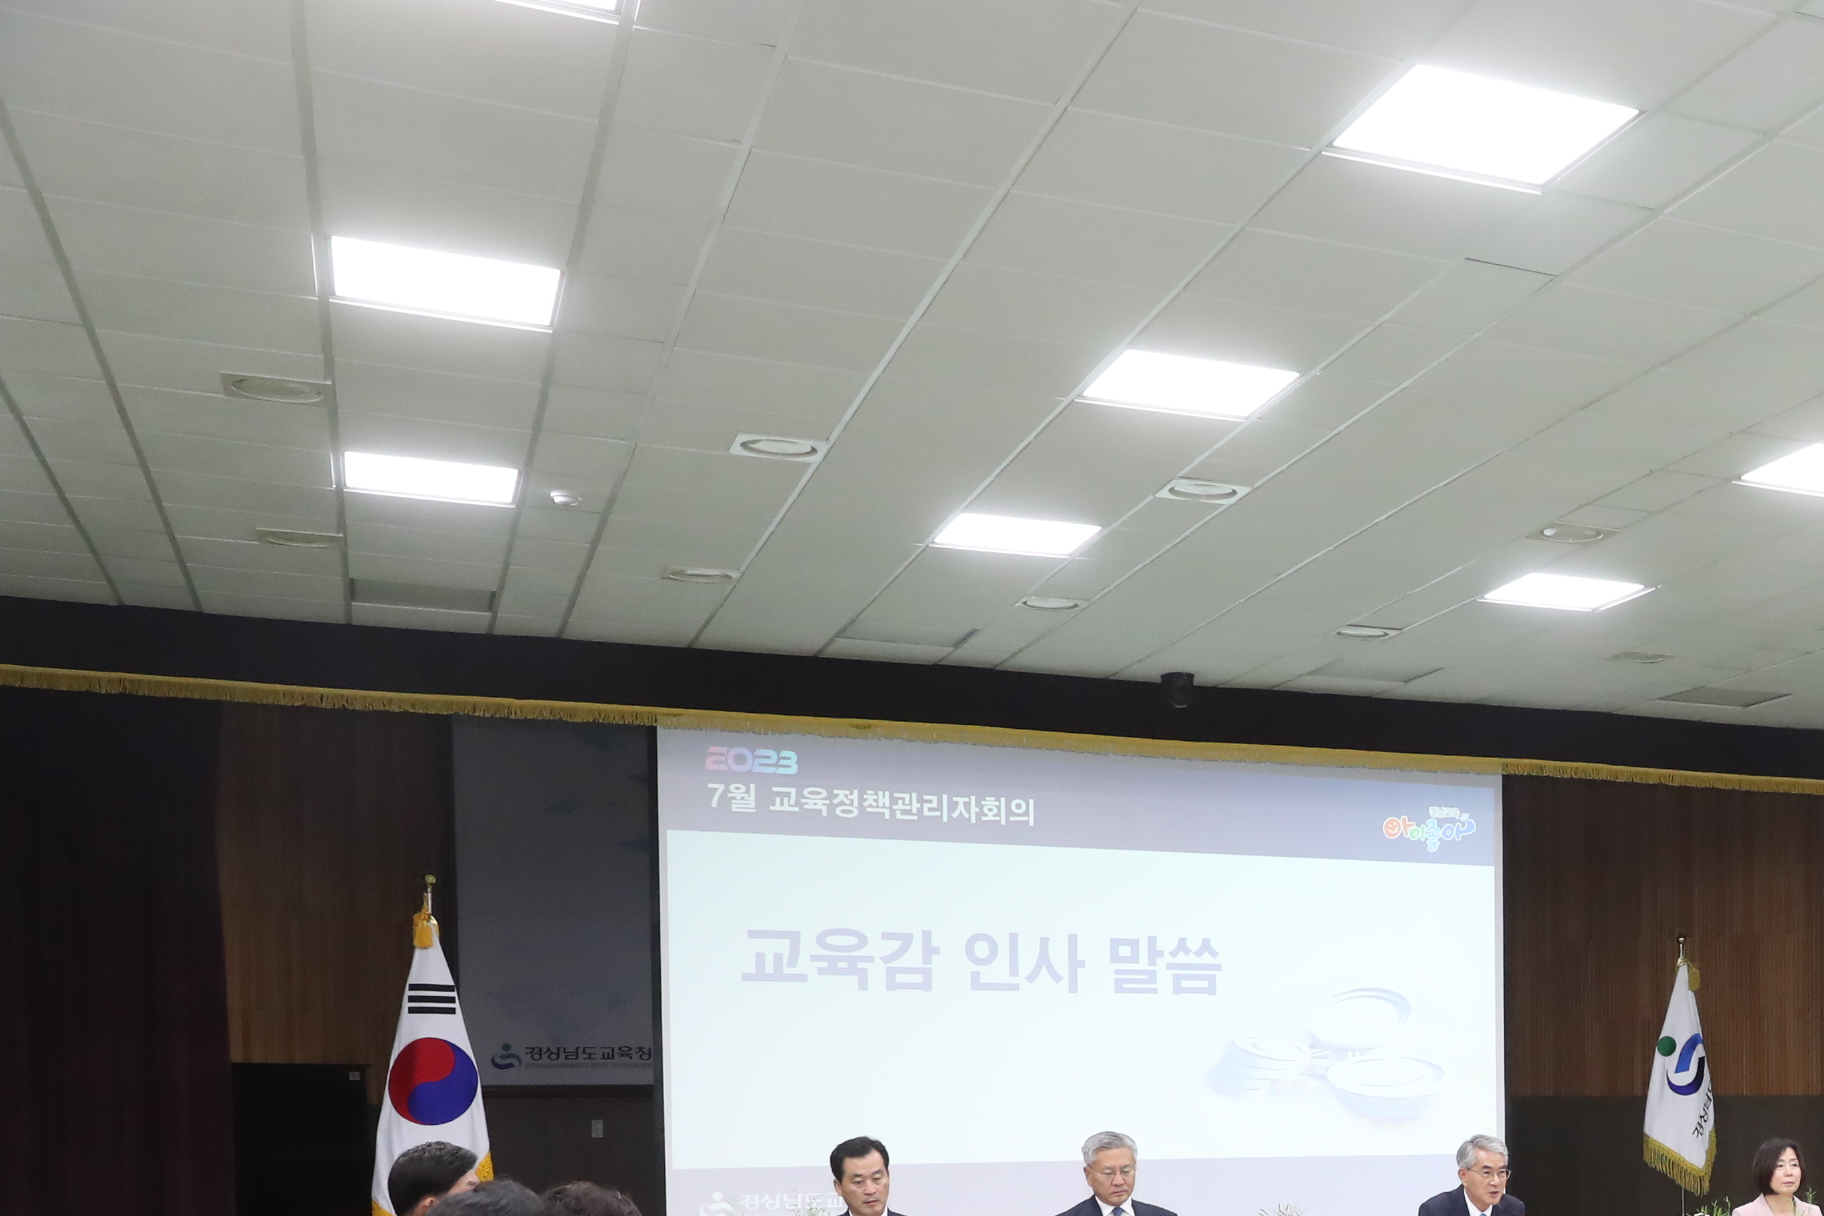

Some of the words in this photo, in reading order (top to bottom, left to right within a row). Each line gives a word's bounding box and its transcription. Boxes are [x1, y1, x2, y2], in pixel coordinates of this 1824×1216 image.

[705, 746, 799, 775] 2023
[706, 783, 757, 812] 7월
[769, 785, 1035, 826] 교육정책관리자회의
[1383, 813, 1476, 852] 아이좋아
[741, 927, 940, 992] 교육감
[964, 931, 1086, 994] 인사
[1109, 935, 1222, 996] 말씀
[525, 1046, 652, 1061] 경상남도교육청
